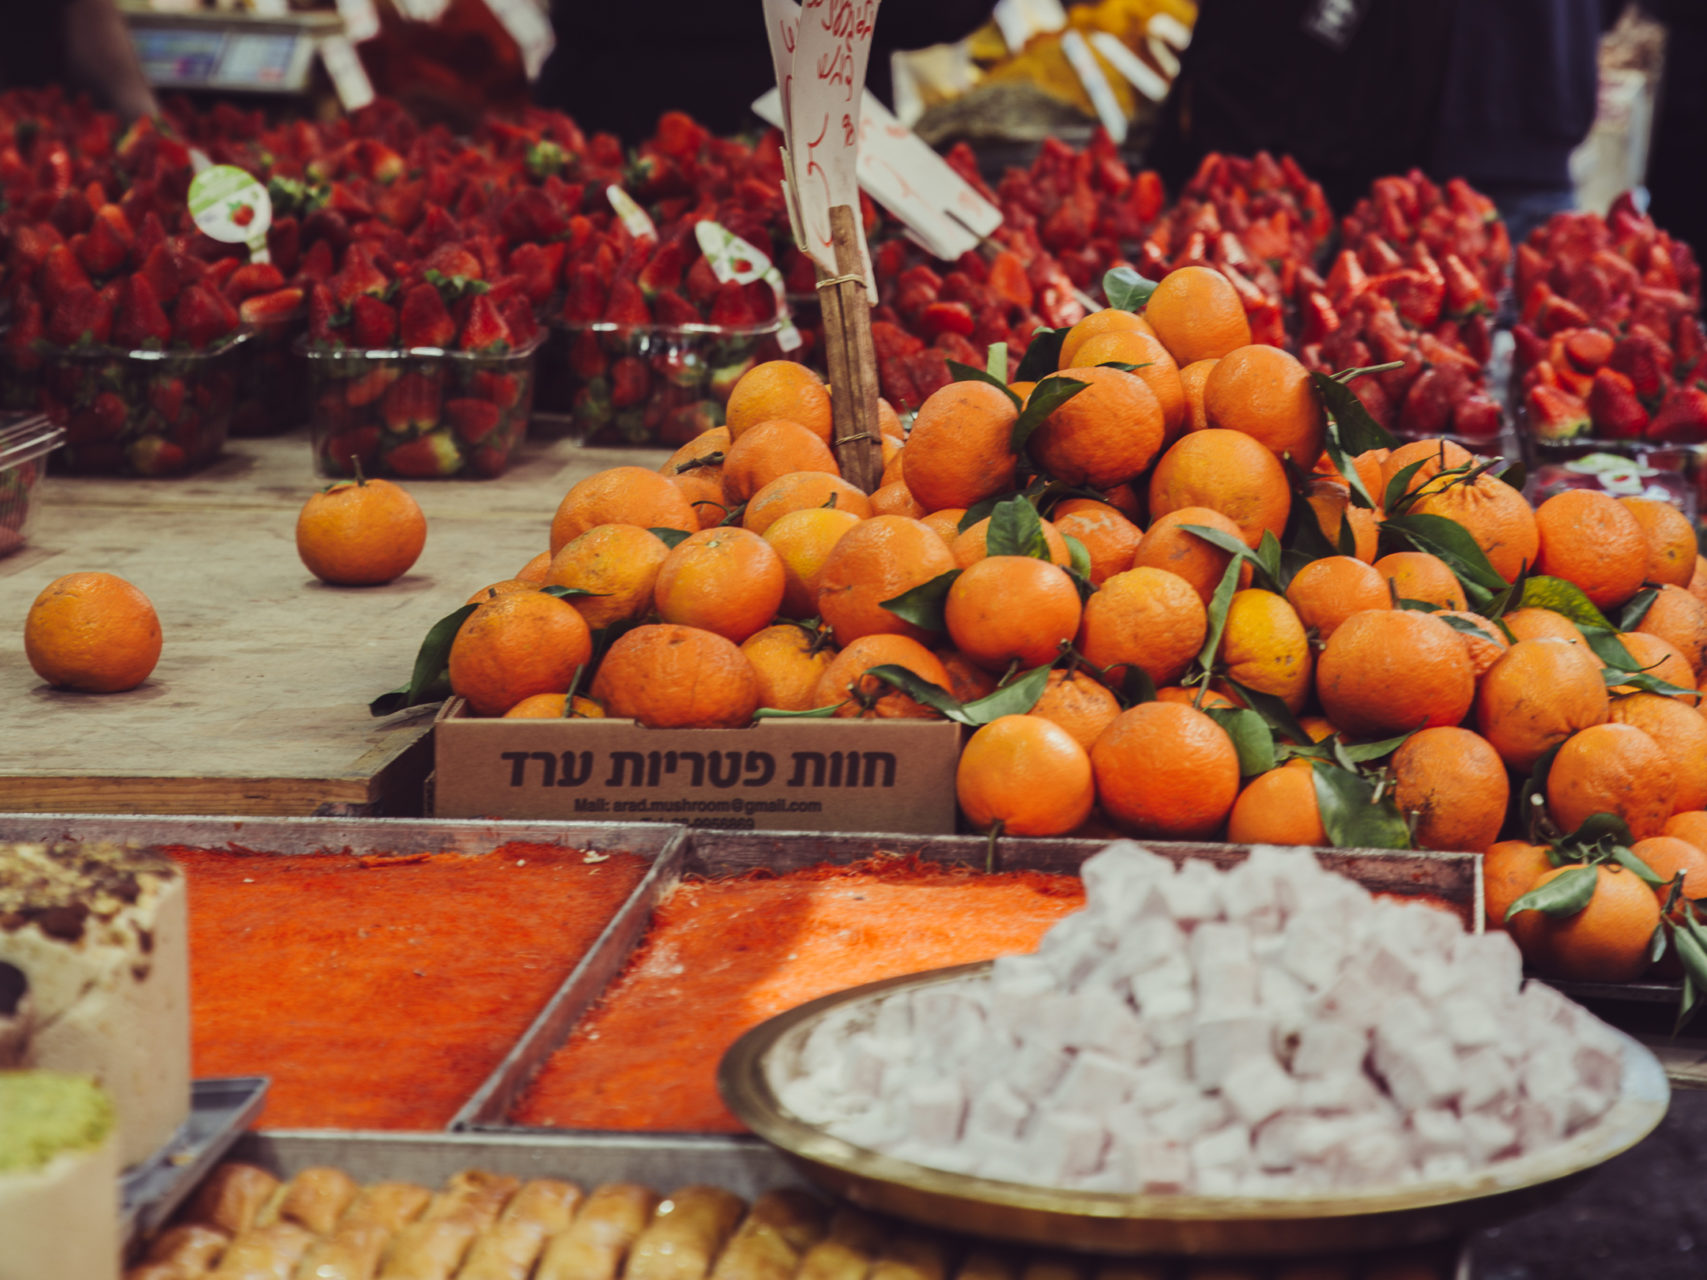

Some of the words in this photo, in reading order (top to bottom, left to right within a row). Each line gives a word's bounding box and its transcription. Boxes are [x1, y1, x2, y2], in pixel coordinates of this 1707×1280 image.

[500, 750, 594, 788] ערד
[605, 750, 776, 789] פטריות
[787, 750, 897, 788] חוות
[573, 798, 610, 812] Mail:
[613, 798, 822, 815] arad.mushroom@gmail.com
